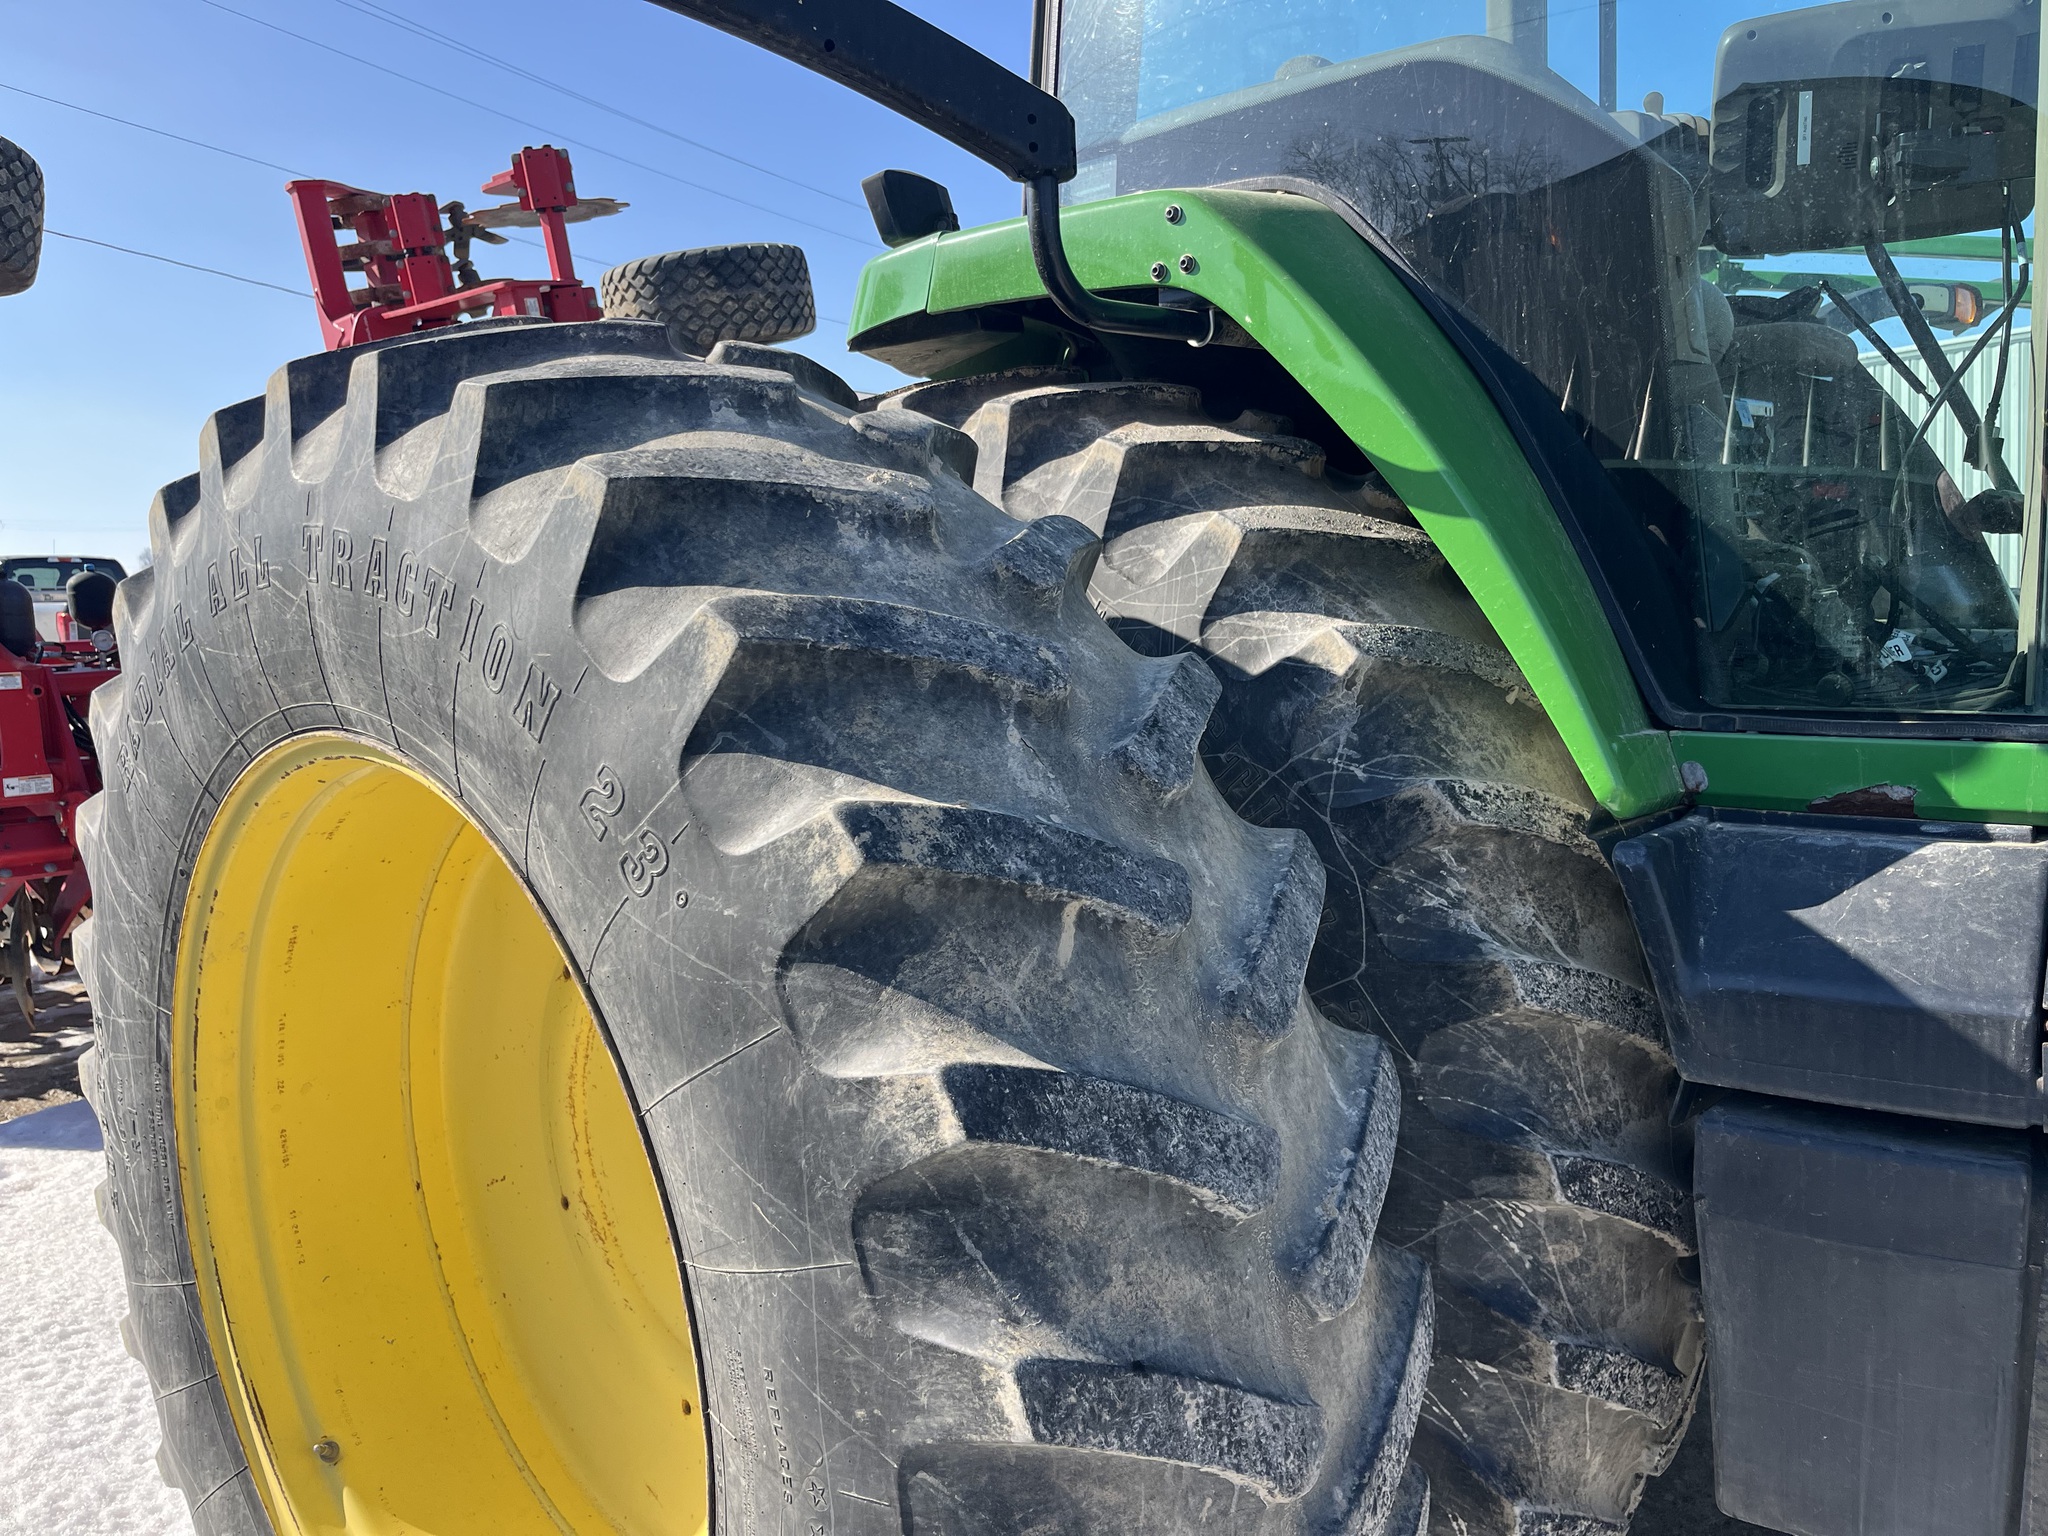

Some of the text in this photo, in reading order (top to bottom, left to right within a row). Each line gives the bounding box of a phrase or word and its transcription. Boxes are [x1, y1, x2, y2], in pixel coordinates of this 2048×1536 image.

[115, 602, 195, 793] RADIAL
[207, 534, 271, 618] ALL
[302, 523, 563, 745] TRACTION
[763, 1367, 794, 1506] REPLACES
